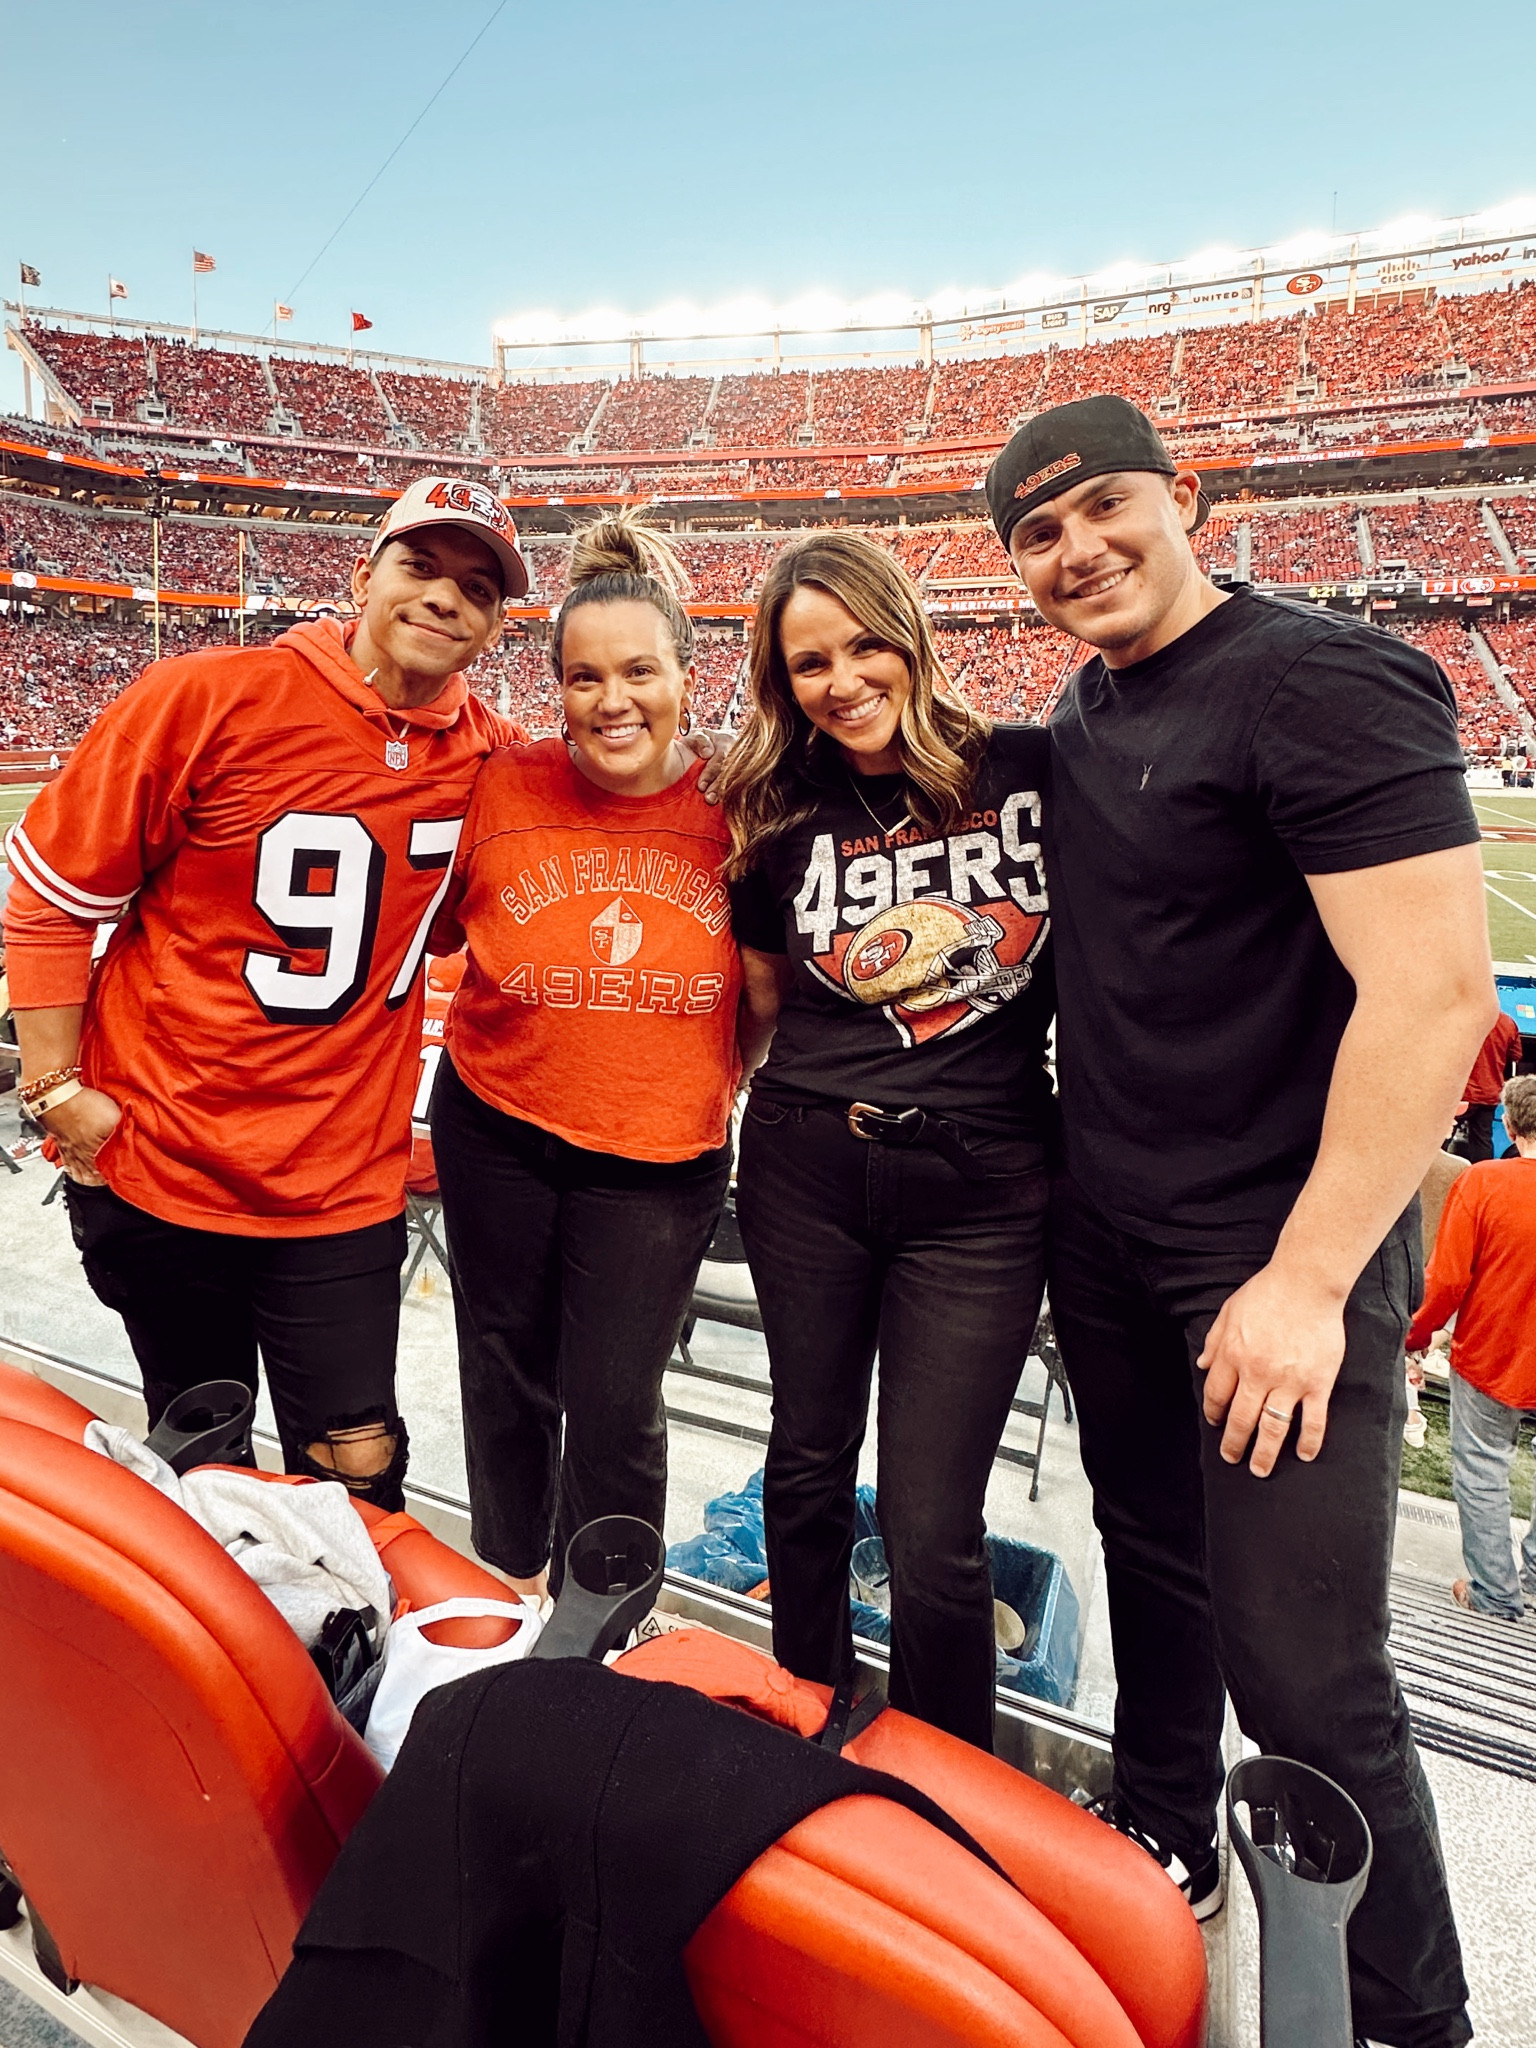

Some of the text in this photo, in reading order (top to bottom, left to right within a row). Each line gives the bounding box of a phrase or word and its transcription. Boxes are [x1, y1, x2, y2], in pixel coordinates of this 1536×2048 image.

[1453, 247, 1510, 270] yahoo!
[1380, 273, 1416, 285] CISCO
[1193, 291, 1239, 304] UNITED
[1094, 305, 1120, 321] SAP
[1149, 301, 1171, 316] nrg
[1001, 320, 1024, 332] Health
[1237, 406, 1291, 419] SUPER
[1297, 401, 1344, 413] BOWL
[1350, 391, 1460, 407] CHAMPIONS
[1277, 453, 1324, 464] HERITAGE
[1327, 450, 1364, 459] MONTH
[1014, 453, 1081, 499] 49ERS
[1308, 585, 1337, 598] 6:21
[951, 599, 1015, 611] HERITAGE
[841, 836, 879, 857] SAN
[793, 790, 1050, 953] 49ERS
[500, 855, 568, 925] SAN
[241, 810, 466, 1025] 97
[500, 963, 724, 1015] 49ERS
